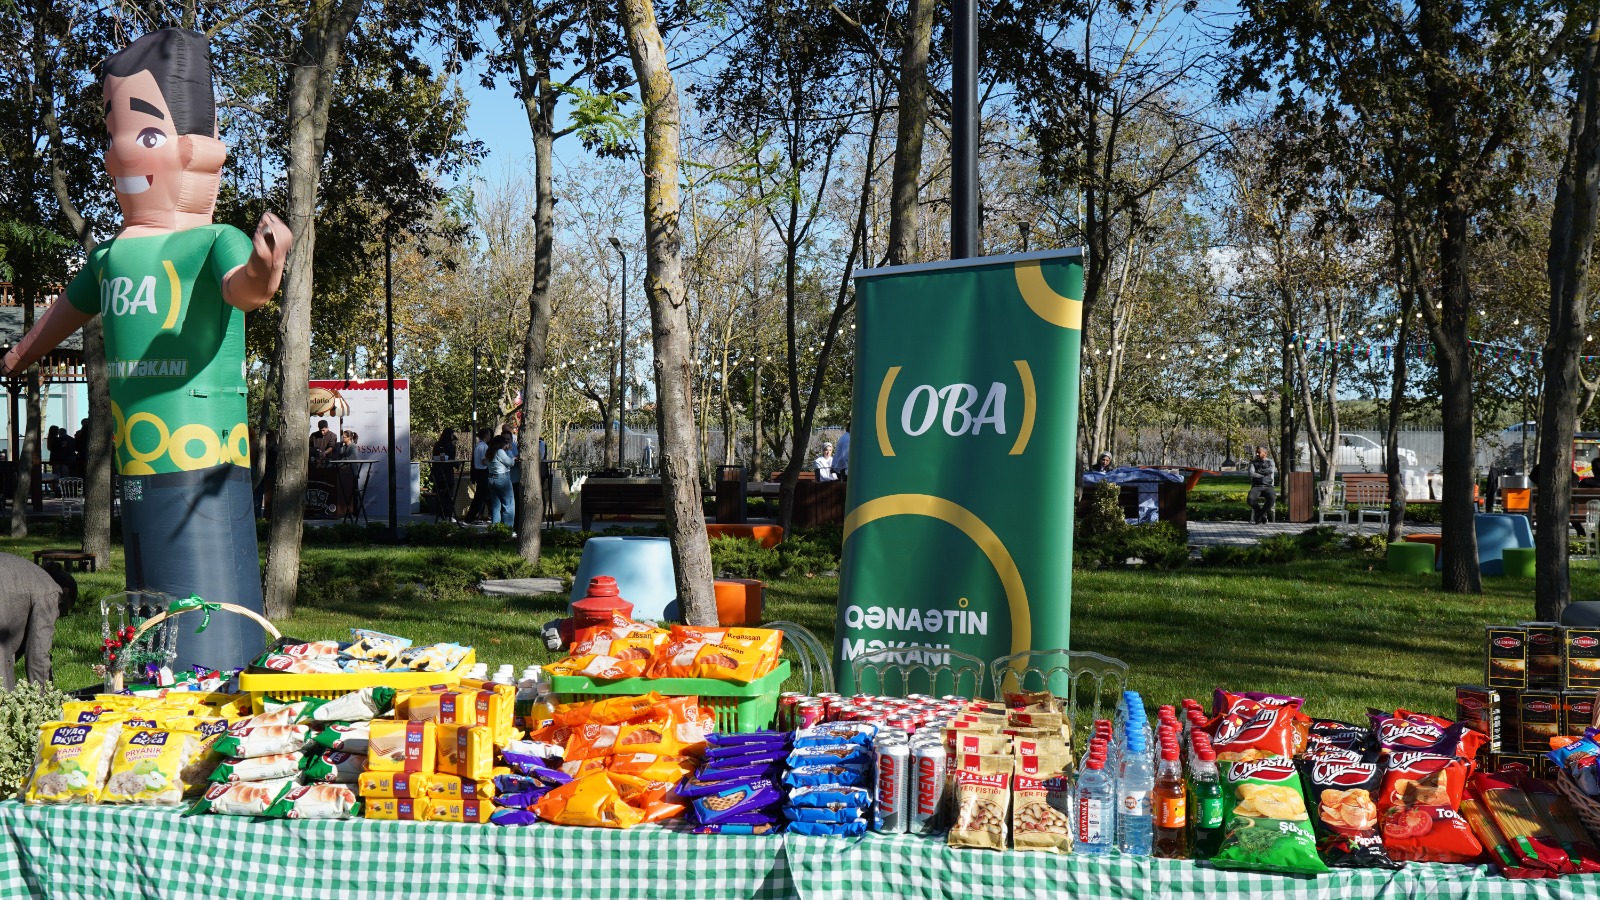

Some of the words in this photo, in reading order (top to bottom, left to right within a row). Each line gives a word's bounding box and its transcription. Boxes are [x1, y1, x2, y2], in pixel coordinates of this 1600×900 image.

[100, 275, 158, 317] OBA
[128, 360, 188, 377] MƏKANI
[900, 381, 1007, 438] OBA
[357, 445, 402, 454] SSMAN
[844, 598, 988, 636] QƏNAƏTİN
[727, 633, 761, 641] Kruassan
[841, 637, 951, 667] MƏKANI
[57, 746, 83, 754] YANİK
[879, 754, 895, 813] TREND
[917, 756, 935, 815] TREND
[1080, 800, 1088, 840] SLAVYANKA
